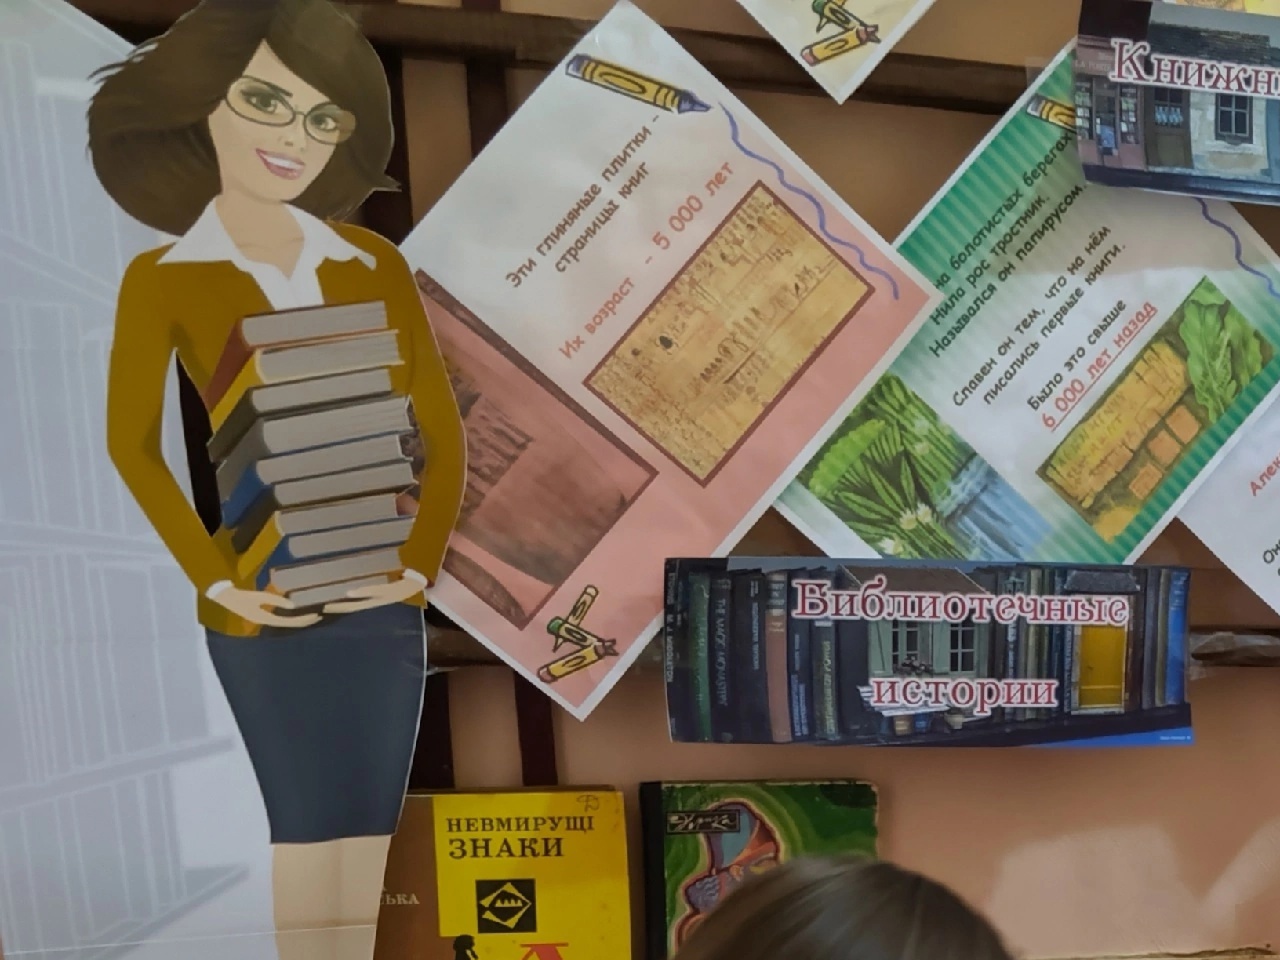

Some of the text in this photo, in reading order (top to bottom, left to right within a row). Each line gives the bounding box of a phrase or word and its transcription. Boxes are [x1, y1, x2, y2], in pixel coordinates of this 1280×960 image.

[505, 258, 538, 288] Эти
[536, 184, 603, 256] глиняные
[602, 126, 652, 182] плитки
[555, 162, 650, 273] страницы книг
[559, 335, 585, 359] Их
[584, 277, 635, 334] возраст
[652, 232, 671, 250] 5
[668, 195, 704, 233] 000
[705, 162, 734, 197] лет
[929, 195, 1050, 325] Нила рос тростник.
[950, 188, 1024, 271] болотистых
[929, 184, 1088, 358] Назывался он папирусом.
[952, 225, 1112, 407] Славен он тем, что на нём
[983, 244, 1127, 406] писались первые книги.
[1027, 299, 1127, 412] Было это свыше
[1042, 300, 1159, 430] 6 000 лет назад
[796, 576, 1128, 622] Библиотечные
[871, 677, 1057, 713] истории
[446, 816, 595, 835] НЕВМИРУЩІ
[448, 837, 564, 859] ЗНАКИ
